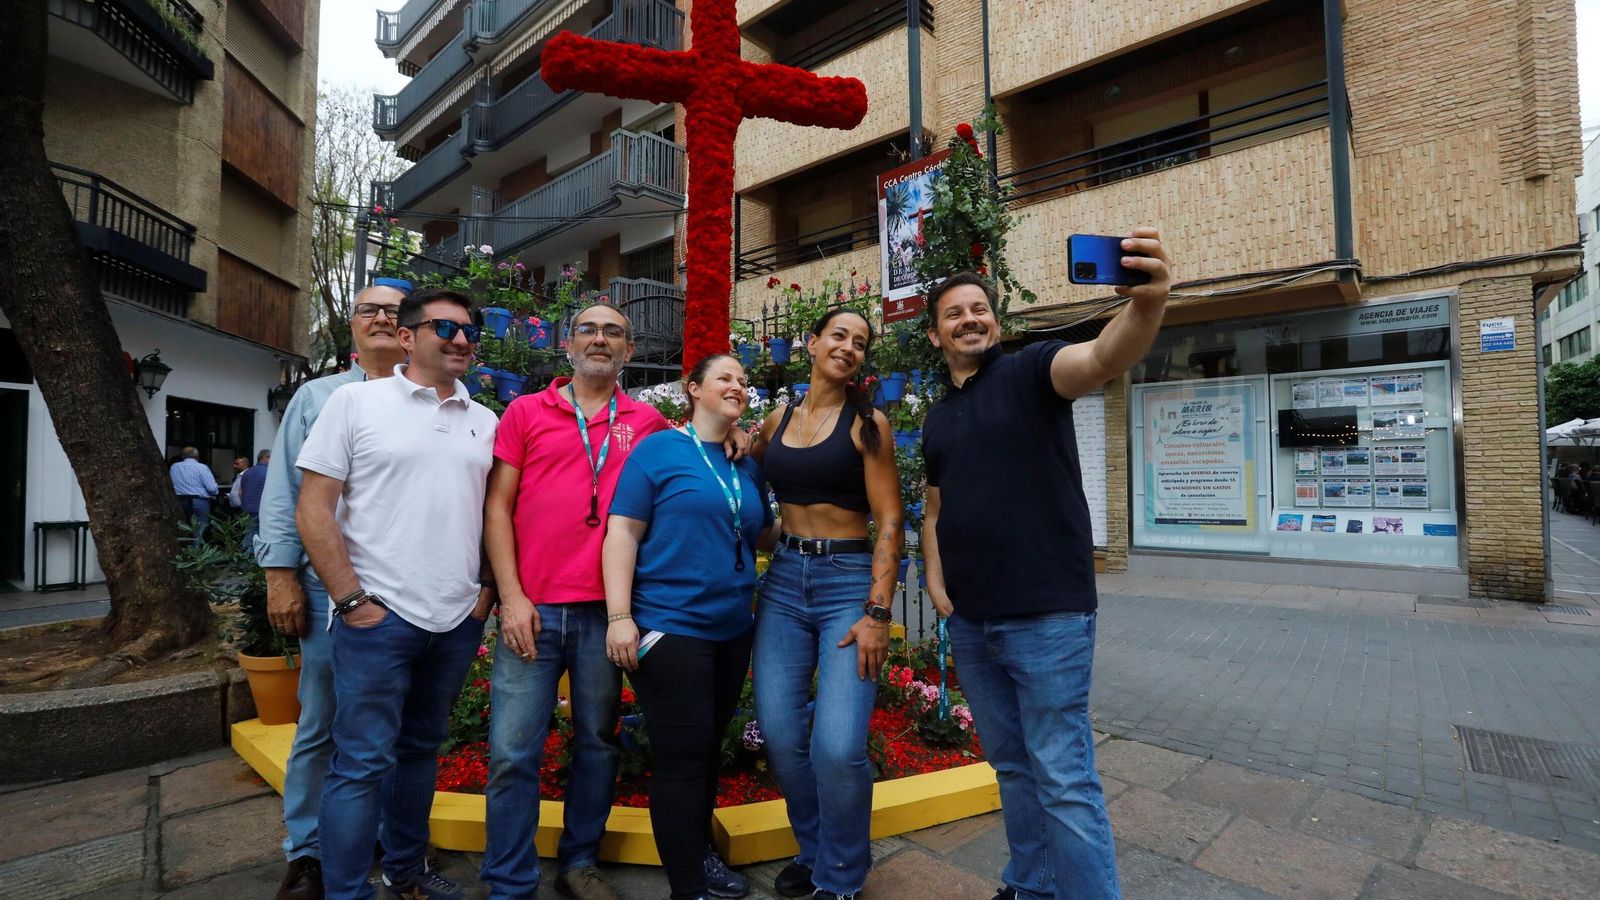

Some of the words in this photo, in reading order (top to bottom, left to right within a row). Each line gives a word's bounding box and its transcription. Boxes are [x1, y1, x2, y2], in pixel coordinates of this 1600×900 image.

[883, 178, 898, 190] CCA
[900, 170, 922, 183] Centro
[924, 158, 948, 174] Córd
[1358, 310, 1393, 320] AGENCIA
[1396, 308, 1407, 316] DE
[1410, 304, 1440, 314] VIAJES
[1360, 312, 1438, 326] www.viajesmarin.com
